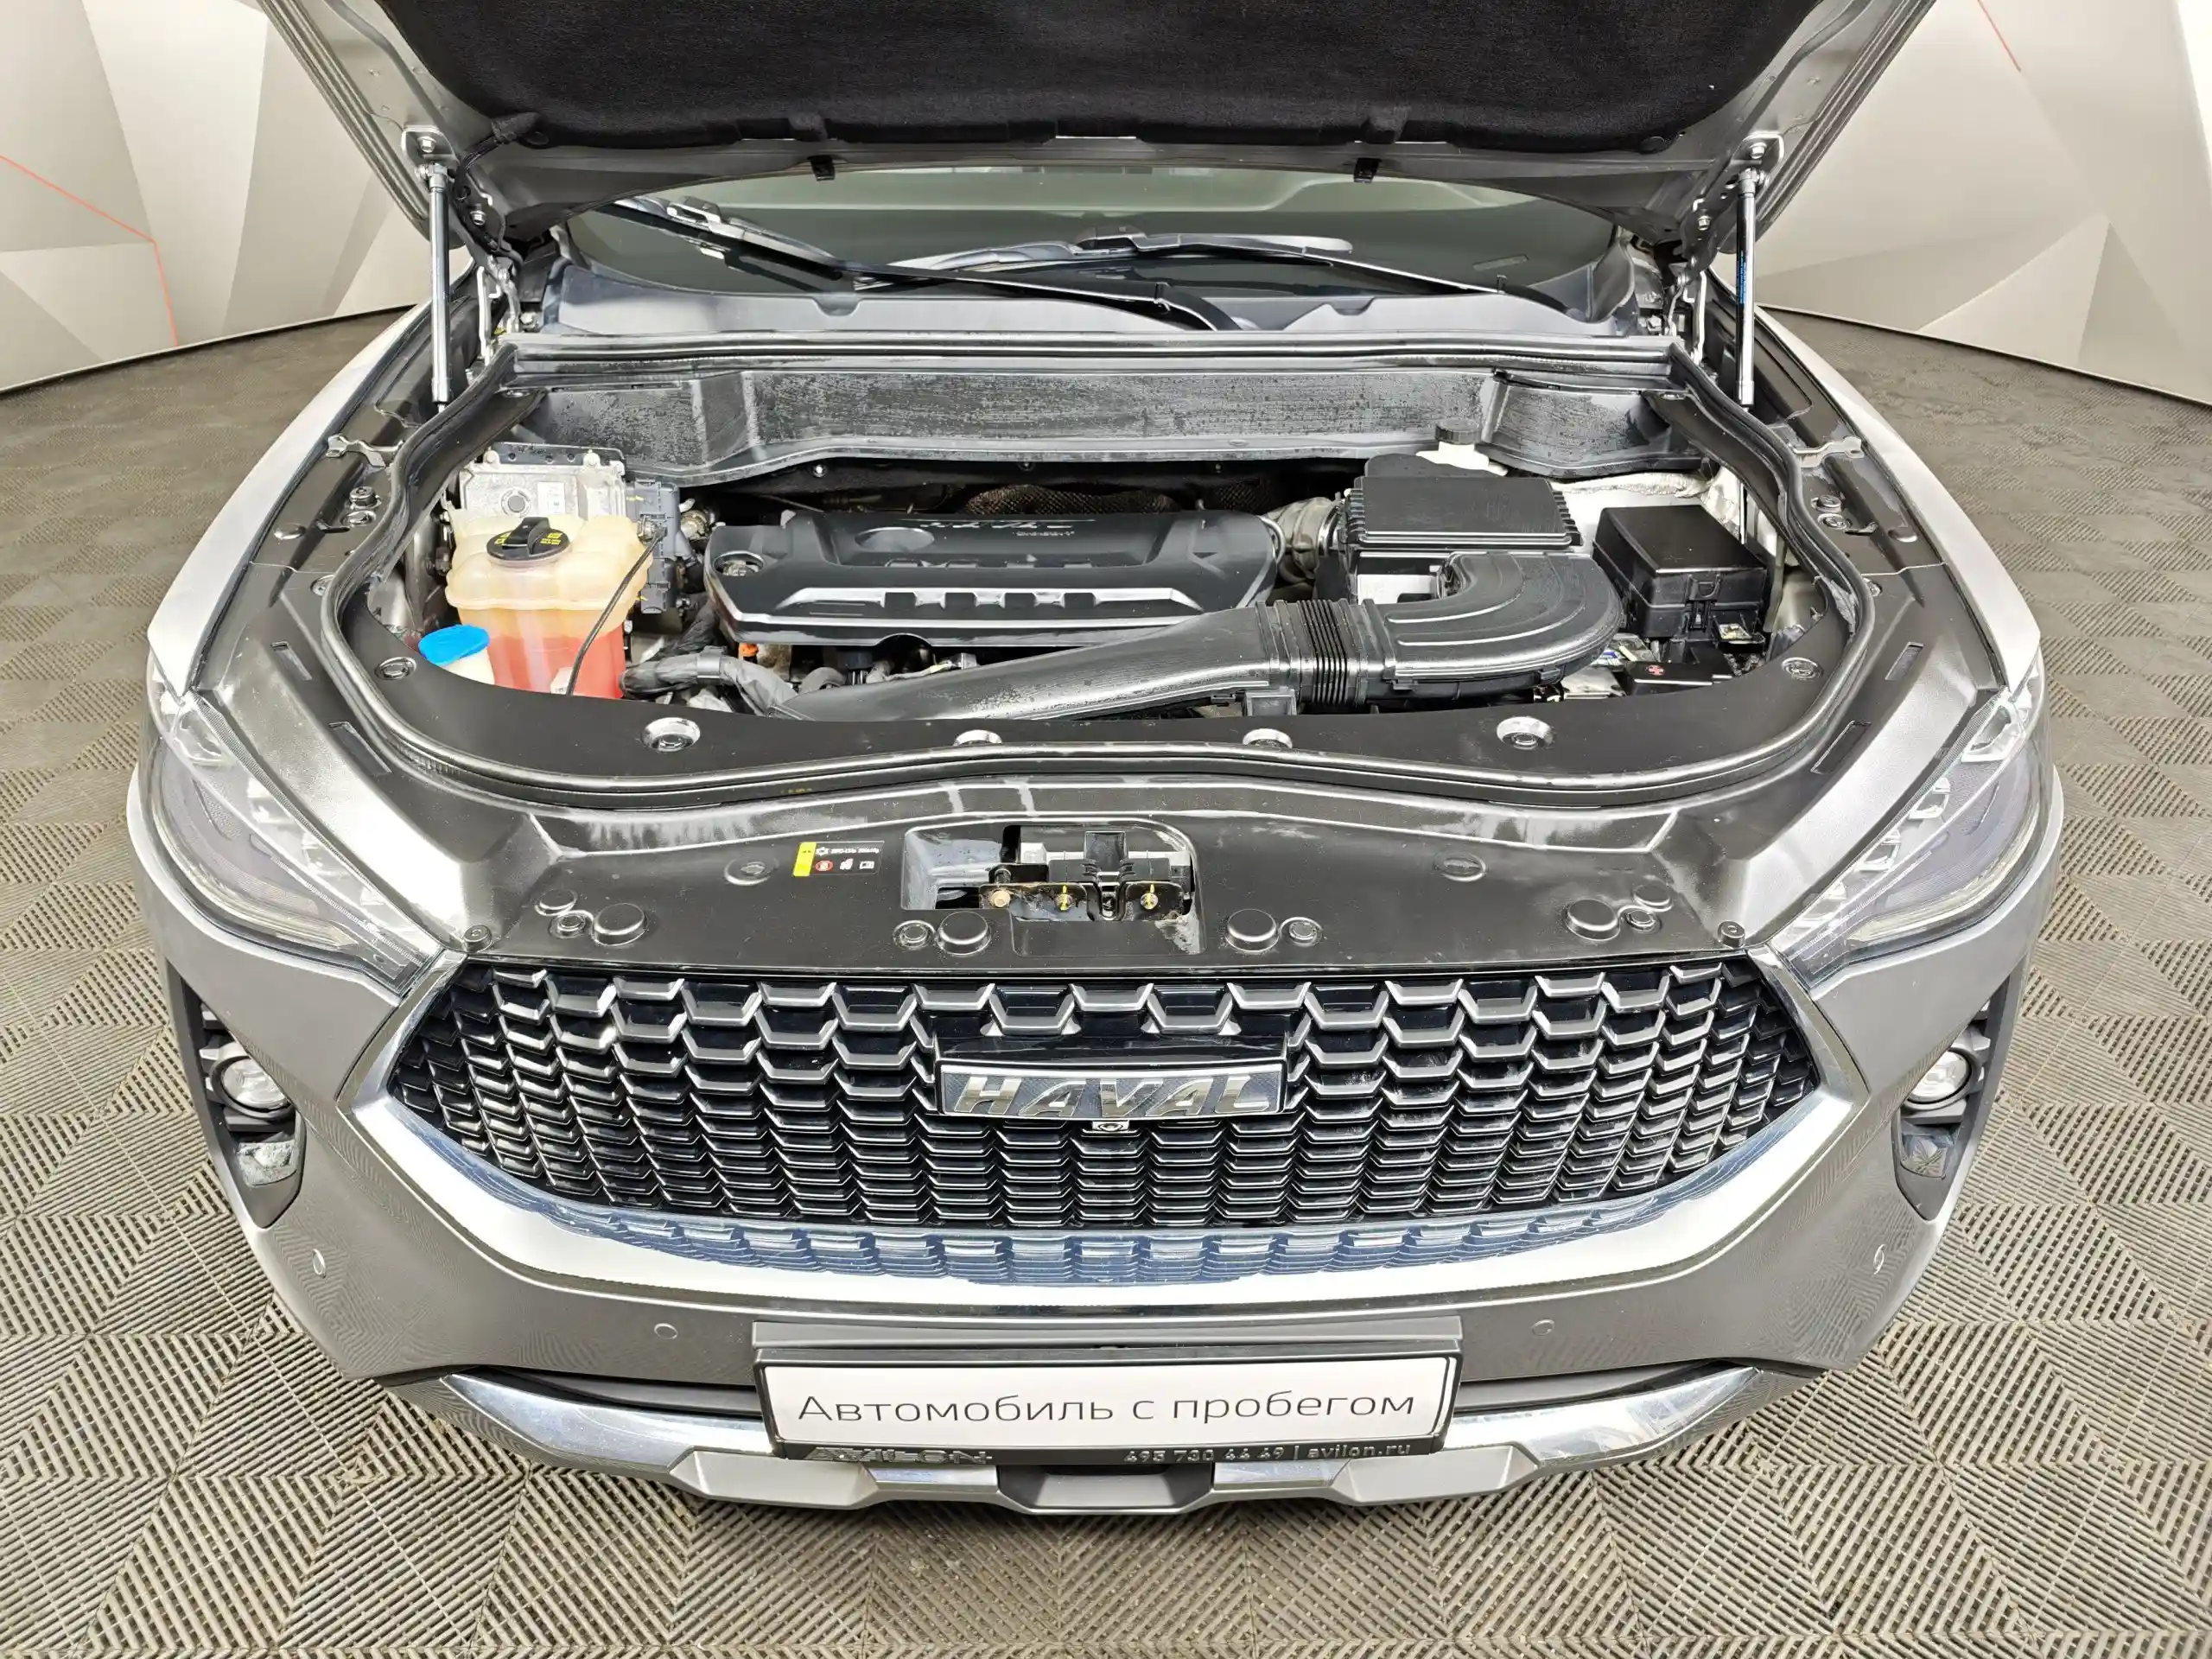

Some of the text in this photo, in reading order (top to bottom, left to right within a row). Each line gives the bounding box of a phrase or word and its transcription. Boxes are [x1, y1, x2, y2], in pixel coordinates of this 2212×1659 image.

[953, 1075, 1271, 1117] HAVAL
[798, 1390, 1414, 1424] Автомобиль с пробегом
[1123, 1450, 1166, 1463] 495
[1173, 1448, 1215, 1462] 730
[1257, 1446, 1285, 1459] 49
[1306, 1444, 1411, 1459] avilon.ru
